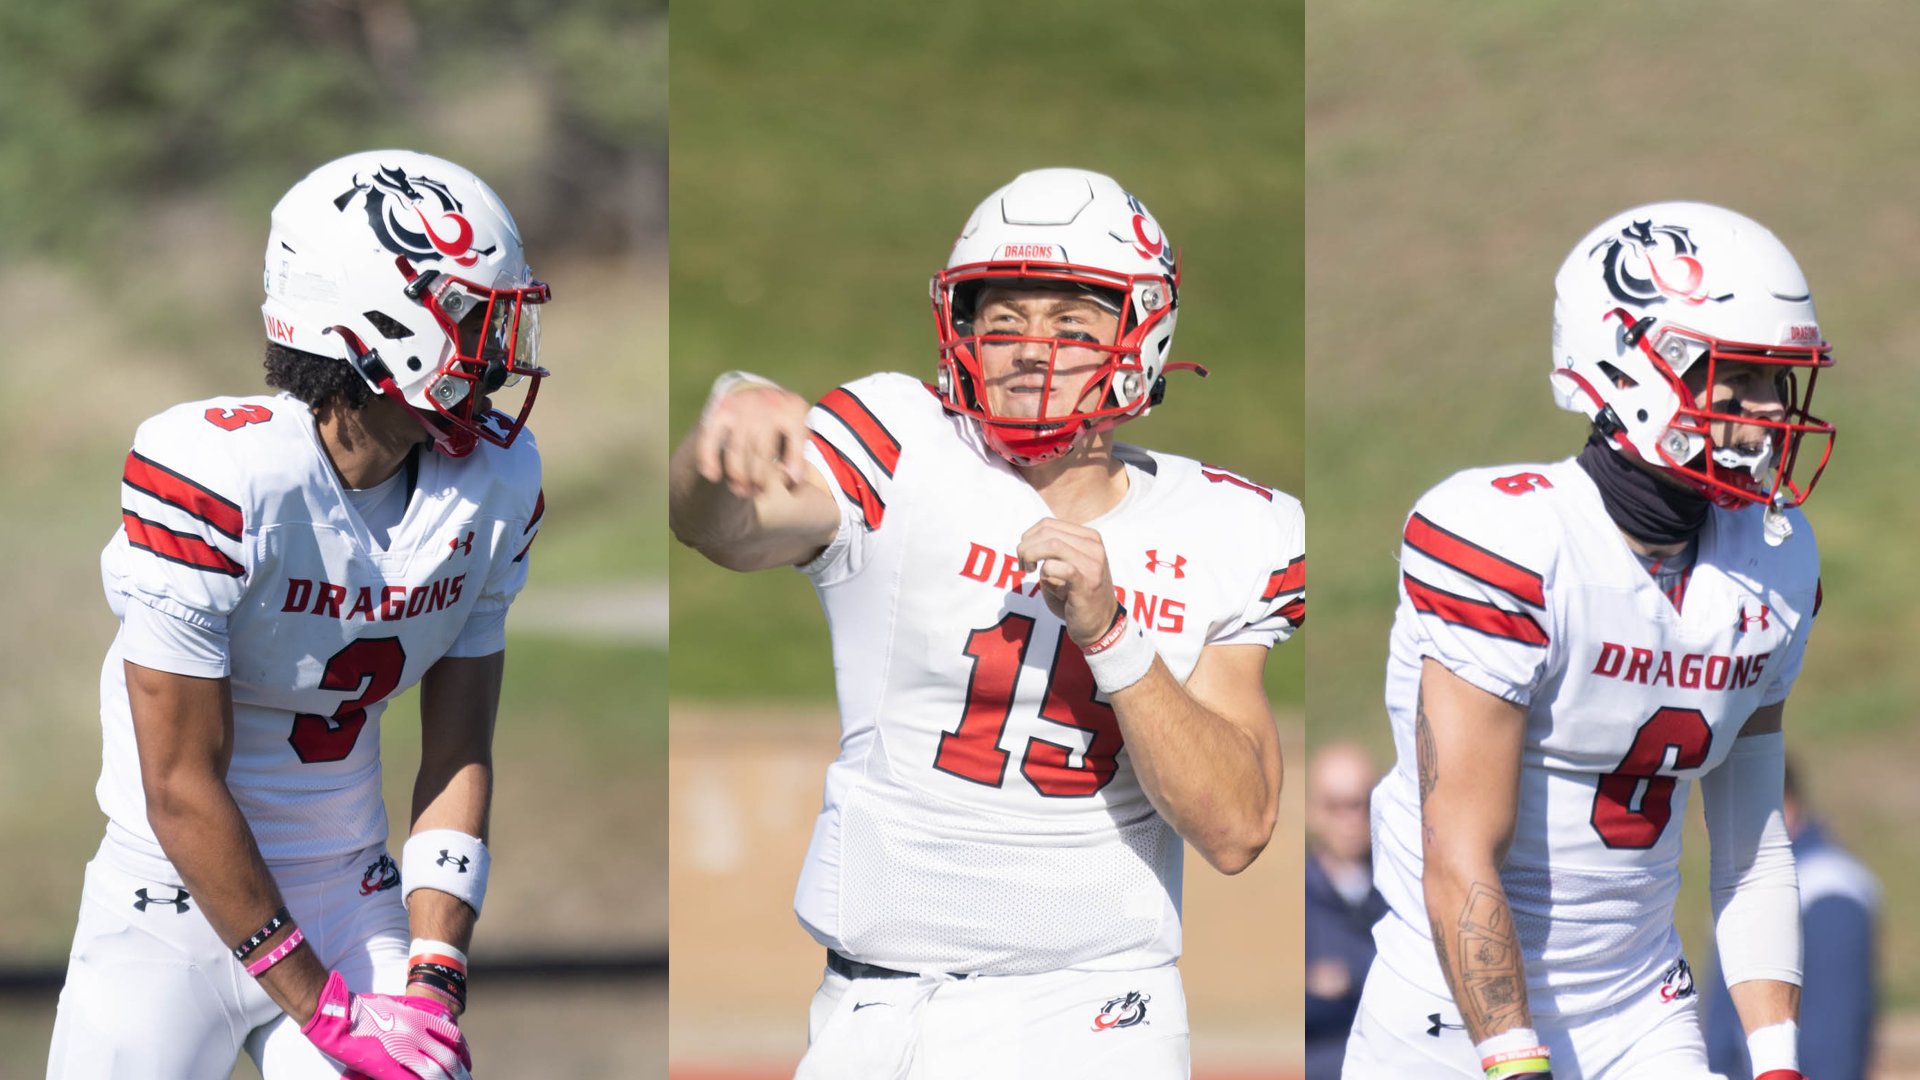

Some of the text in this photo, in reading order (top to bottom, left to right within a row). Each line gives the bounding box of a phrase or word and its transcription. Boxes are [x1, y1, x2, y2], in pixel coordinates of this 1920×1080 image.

[1004, 245, 1053, 258] DRAGONS
[265, 314, 294, 343] WAY
[204, 404, 273, 431] 3
[1490, 471, 1554, 496] 6
[281, 572, 466, 621] DRAGONS
[959, 542, 1186, 633] DRNS
[1591, 642, 1771, 690] DRAGONS
[288, 636, 406, 763] 3
[933, 612, 1124, 798] 15
[1590, 706, 1713, 850] 6
